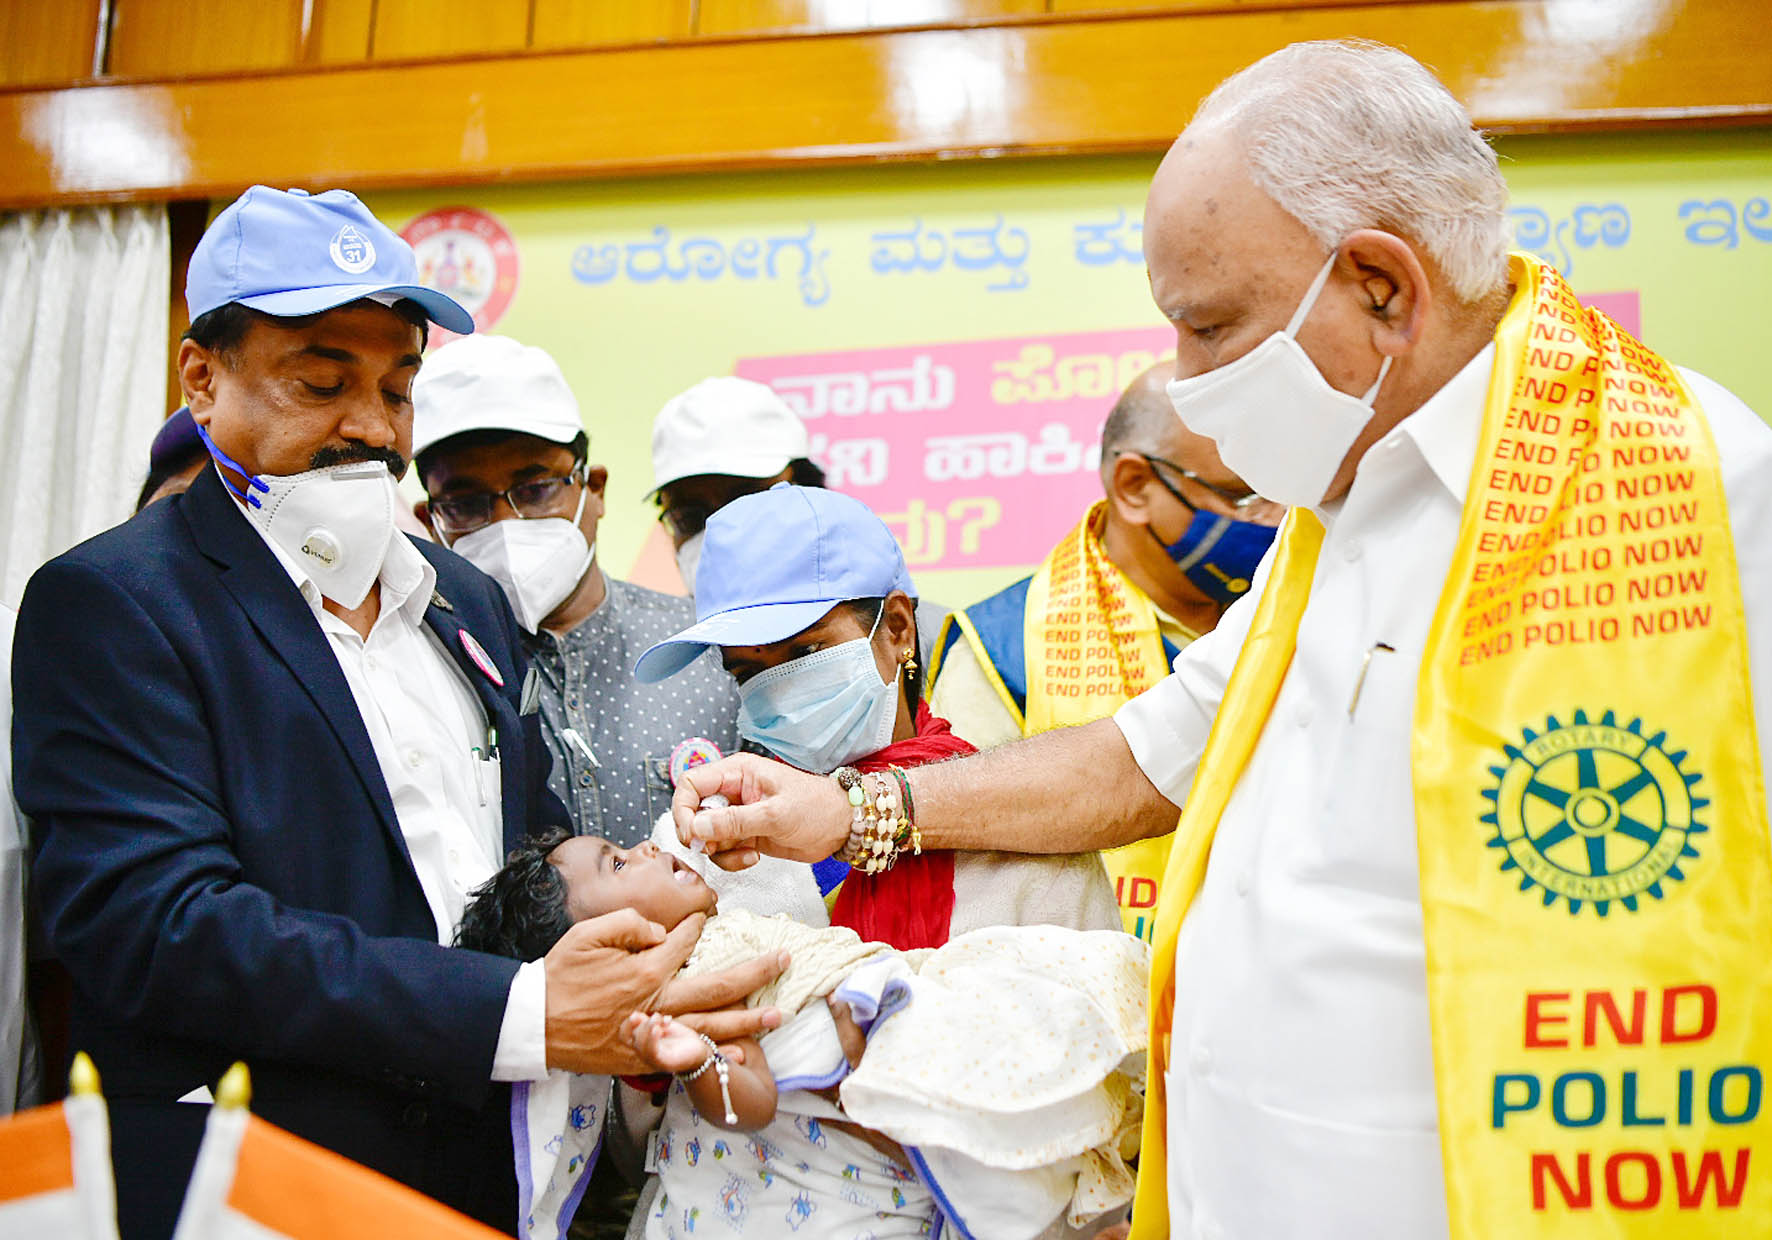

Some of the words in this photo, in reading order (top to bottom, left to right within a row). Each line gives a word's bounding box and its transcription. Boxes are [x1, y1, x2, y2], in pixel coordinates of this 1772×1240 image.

[571, 221, 830, 306] ಆರೋಗ್ಯ
[871, 216, 1030, 292] ಮತ್ತು
[1534, 323, 1577, 344] ND
[1525, 347, 1574, 372] ND
[1604, 377, 1675, 399] NOW
[1608, 397, 1680, 418] NOW
[1610, 421, 1686, 439] NOW
[1495, 439, 1557, 465] END
[1613, 446, 1691, 468] NOW
[1489, 469, 1553, 496] END
[1616, 471, 1695, 500] NOW
[1484, 500, 1549, 525] END
[1620, 501, 1698, 534] NOW
[1478, 532, 1541, 553] END
[1538, 547, 1612, 577] OLIO
[1625, 533, 1703, 567] NOW
[1463, 601, 1512, 638] END
[1521, 582, 1615, 615] POLIO
[1628, 568, 1708, 602] NOW
[1045, 612, 1081, 624] END
[1045, 630, 1081, 642] END
[1459, 631, 1514, 667] END
[1524, 617, 1620, 648] POLIO
[1632, 604, 1712, 638] NOW
[1045, 648, 1081, 660] END
[1086, 647, 1117, 660] POL
[1046, 665, 1081, 678] END
[1046, 683, 1080, 697] END
[1086, 683, 1124, 696] POLI
[1536, 728, 1634, 756] ROTARY
[1520, 838, 1676, 895] INTERNATIONAL
[1523, 984, 1719, 1049] END
[1492, 1064, 1763, 1130] POLIO
[1531, 1147, 1751, 1213] NOW
